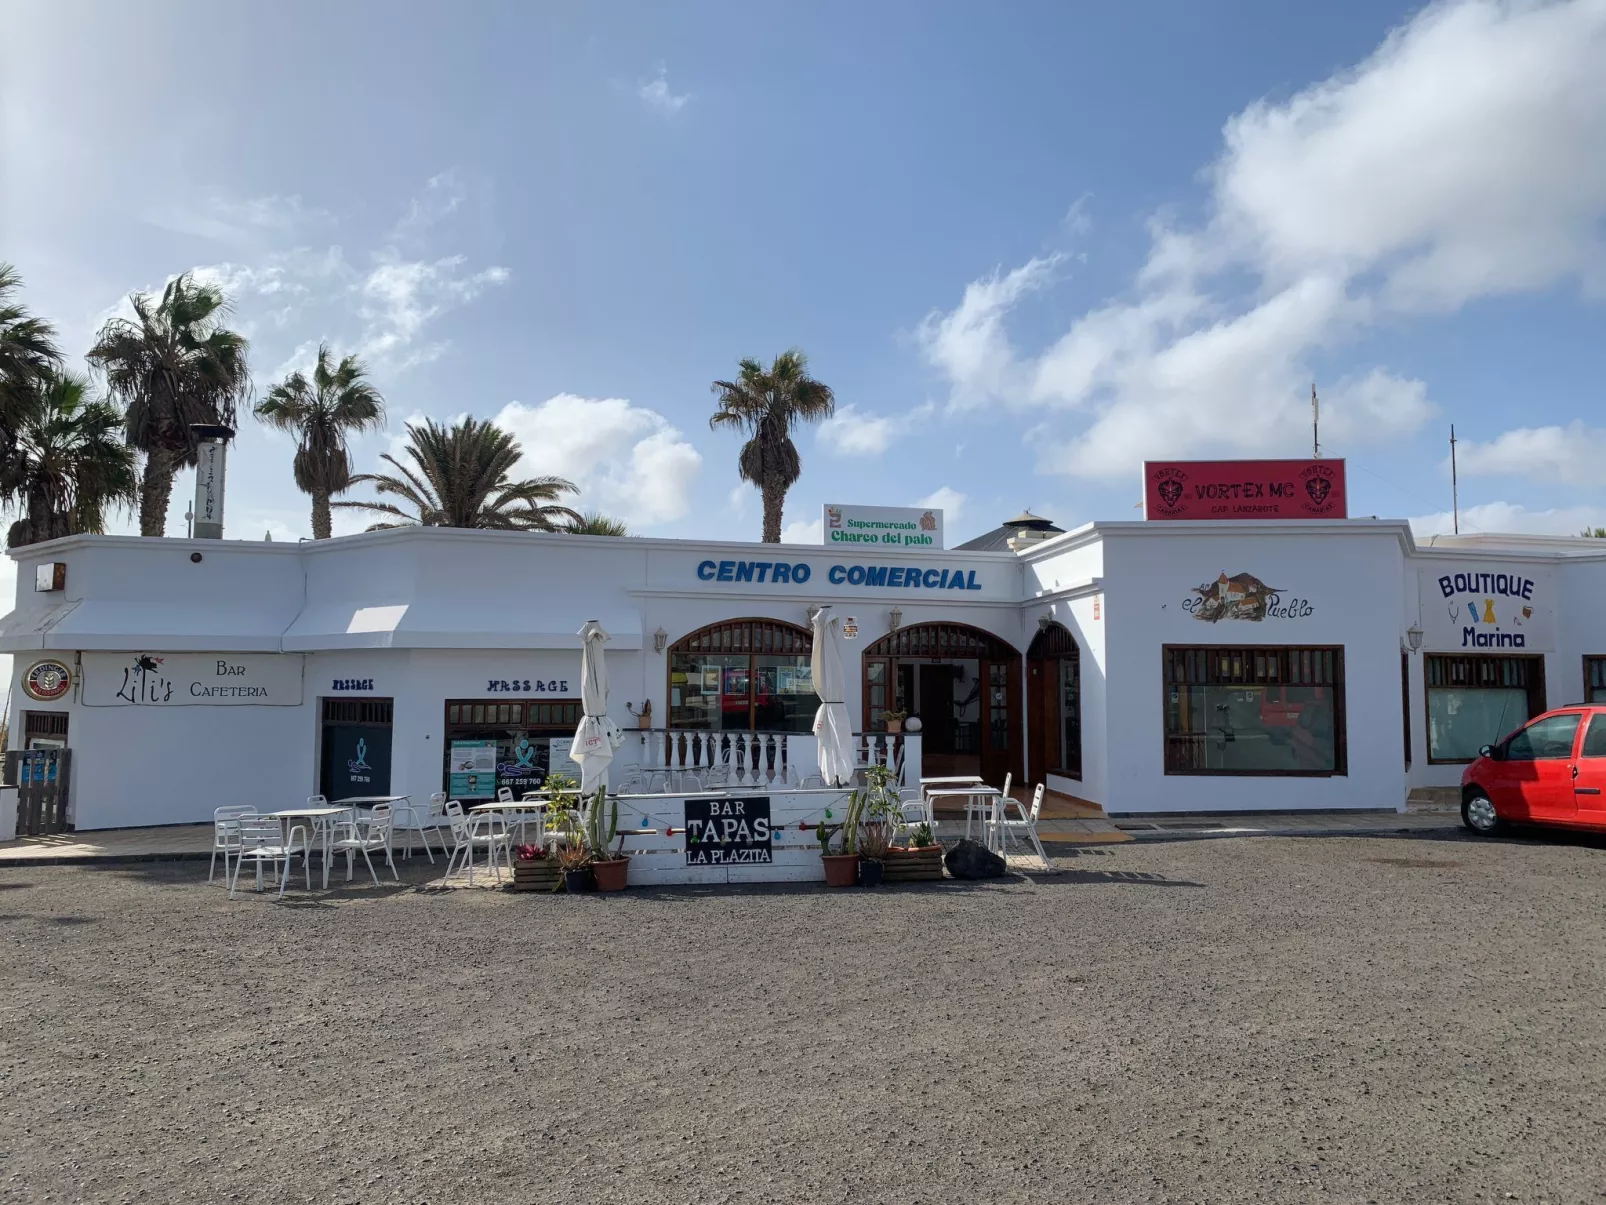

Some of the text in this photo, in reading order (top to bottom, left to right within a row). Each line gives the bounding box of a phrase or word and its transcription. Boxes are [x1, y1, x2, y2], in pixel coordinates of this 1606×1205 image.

[1194, 482, 1264, 499] VORTEX
[1269, 482, 1296, 498] MC
[1232, 504, 1280, 513] LANZAROTE
[847, 519, 917, 530] Supermercado
[831, 530, 933, 546] Charco del palo
[697, 560, 982, 590] CENTRO COMERCIAL
[1438, 573, 1535, 601] BOUTIQUE
[1181, 593, 1315, 619] el Pueblo
[1462, 626, 1526, 648] Marina
[487, 680, 568, 692] MASSAGE
[709, 801, 746, 816] BAR
[687, 818, 770, 844] TAPAS
[687, 848, 771, 864] LA PLAZITA
